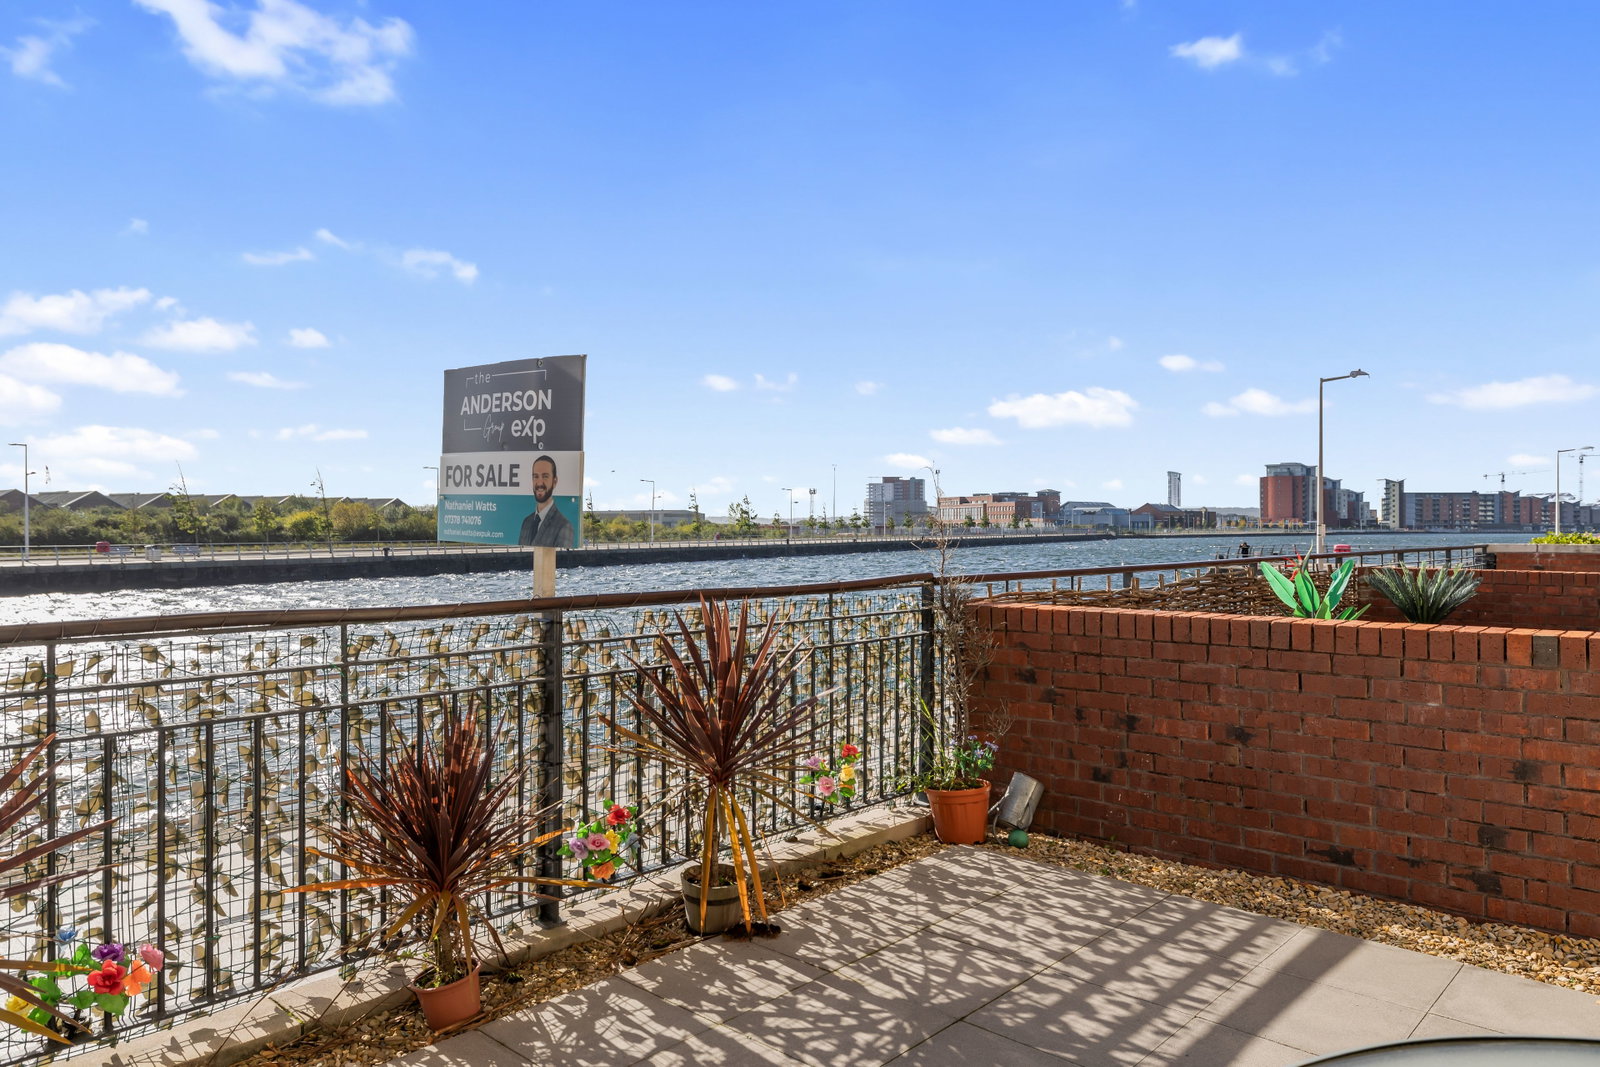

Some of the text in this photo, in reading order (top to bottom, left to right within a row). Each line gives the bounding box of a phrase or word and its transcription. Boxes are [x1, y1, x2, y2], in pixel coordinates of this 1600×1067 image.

[474, 372, 491, 385] the
[460, 389, 552, 415] ANDERSON
[445, 464, 520, 487] FOR SALE
[445, 501, 497, 511] Nathaniel Watts
